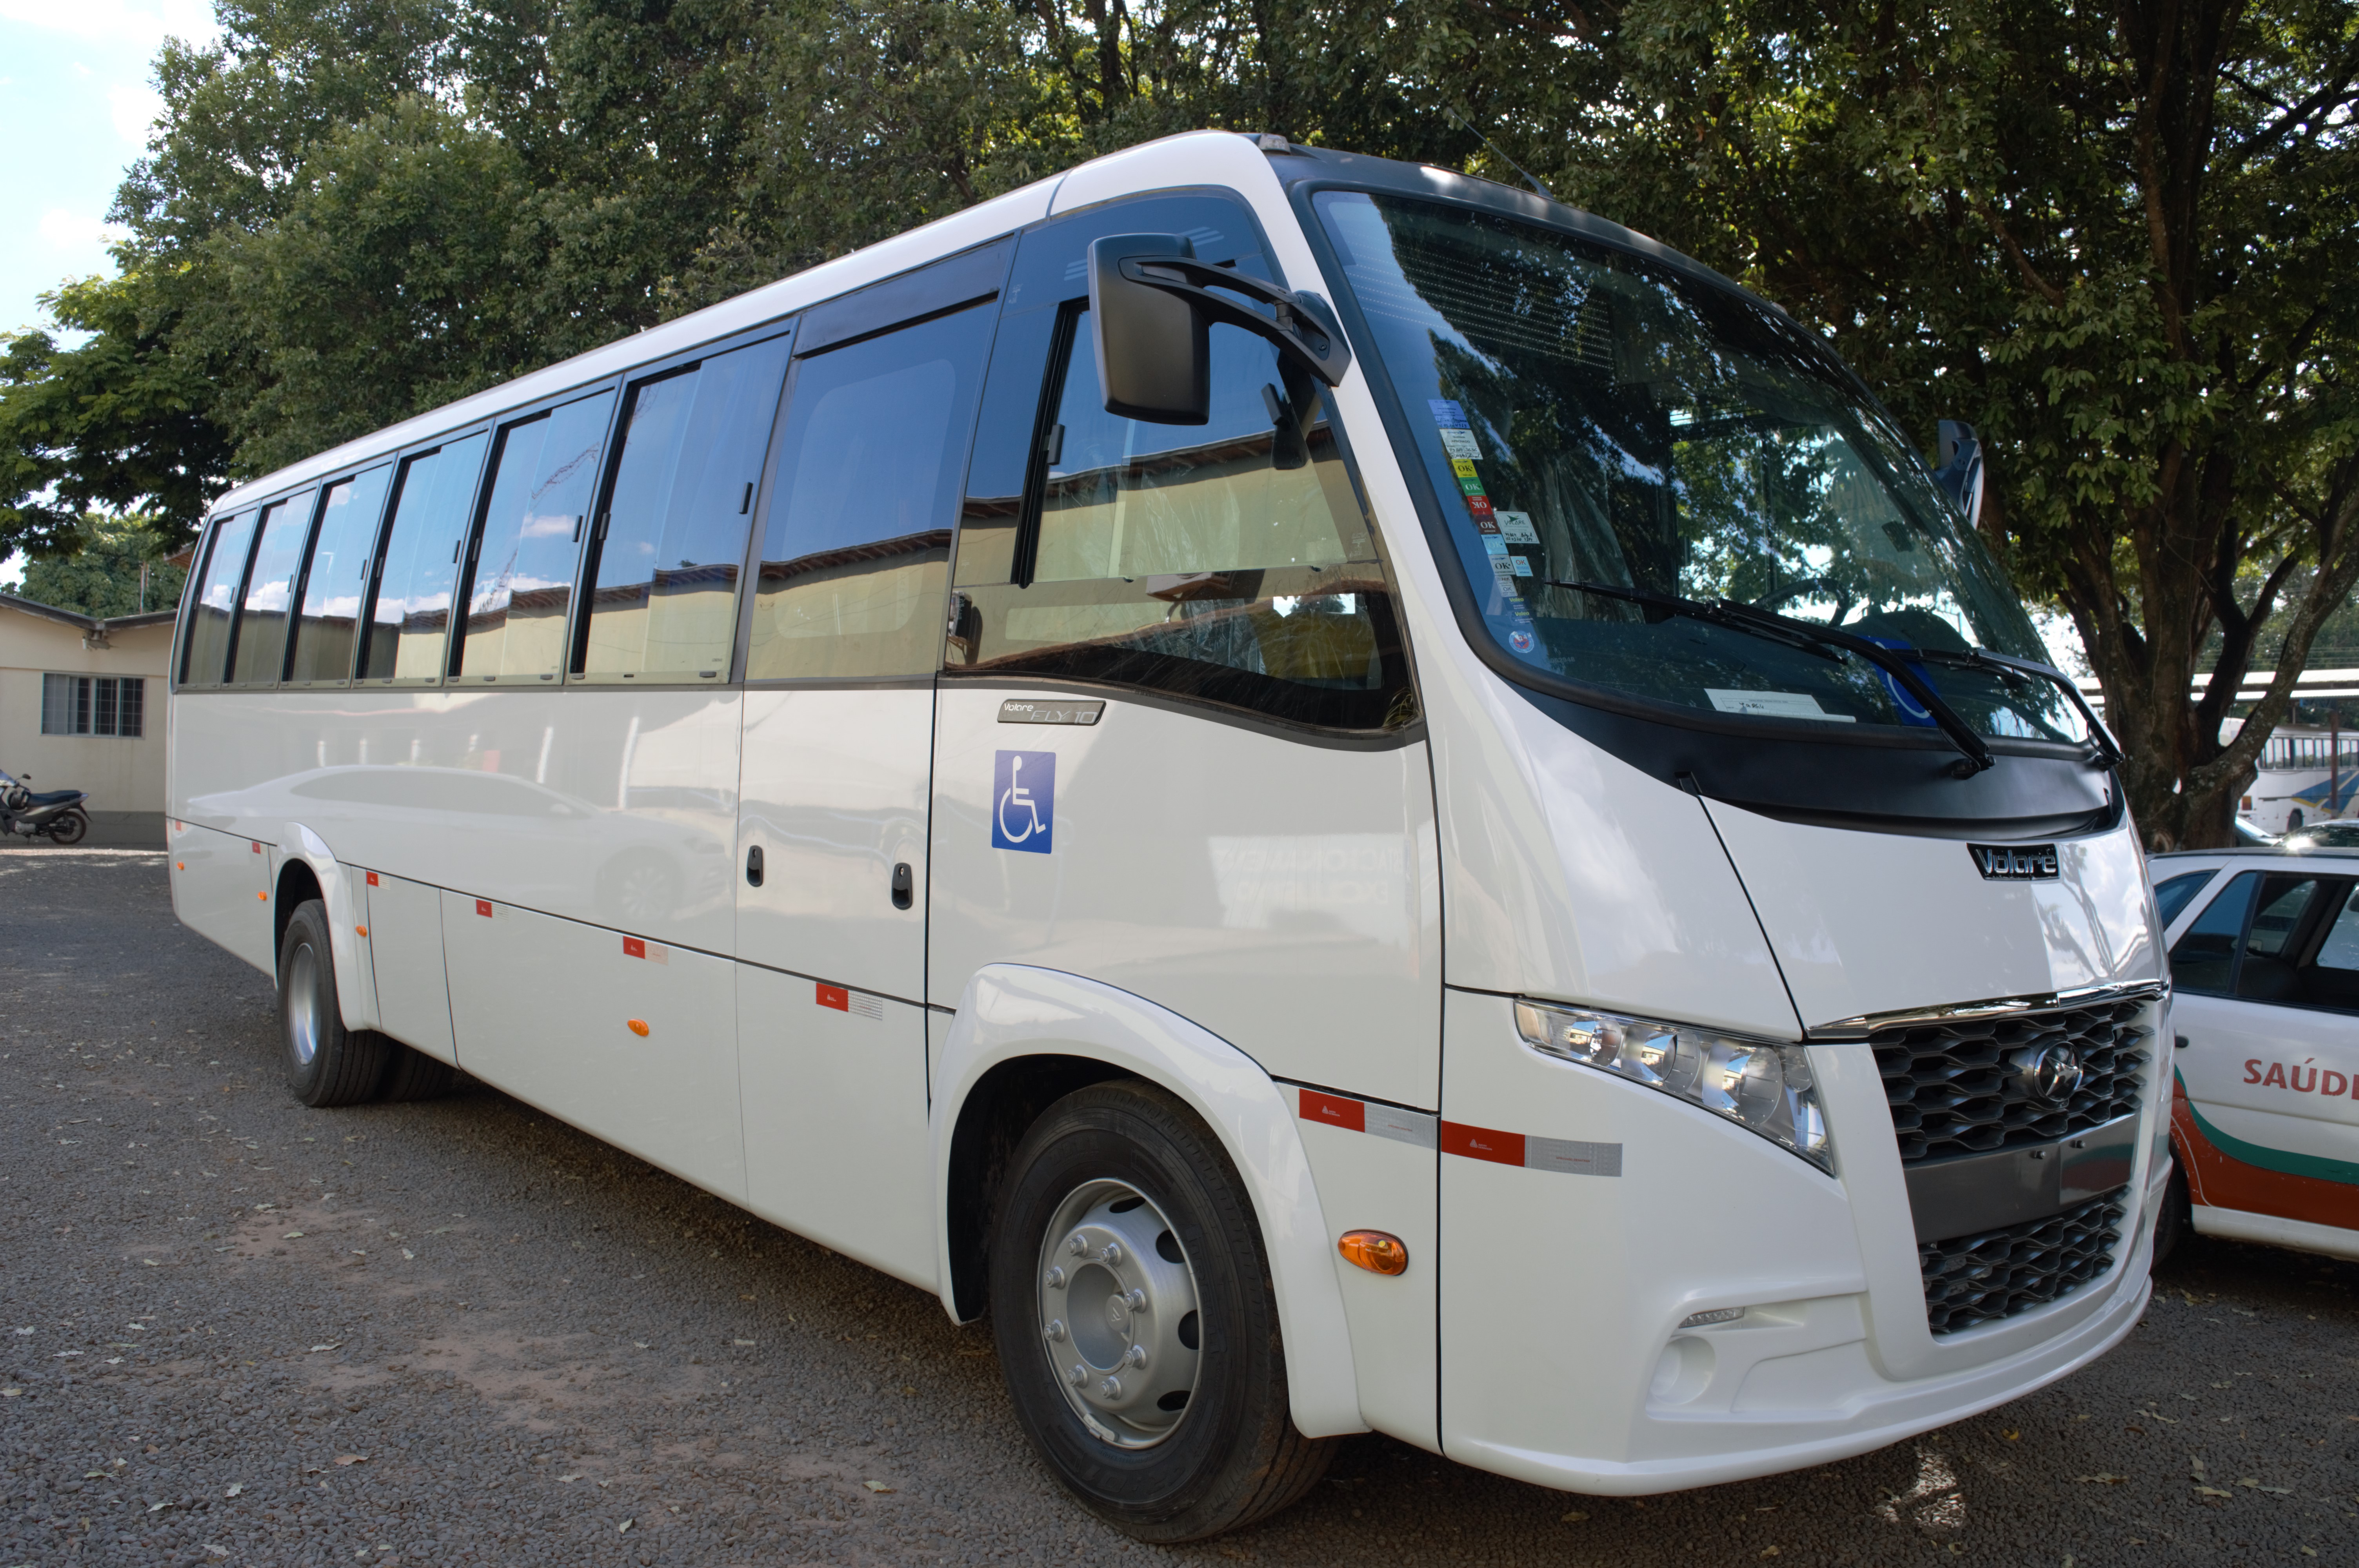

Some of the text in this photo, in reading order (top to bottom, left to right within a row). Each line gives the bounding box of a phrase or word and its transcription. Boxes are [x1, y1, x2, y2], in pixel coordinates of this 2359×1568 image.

[1004, 702, 1034, 711] Volare
[1030, 710, 1098, 724] FLY 10
[1975, 849, 2057, 874] Volare
